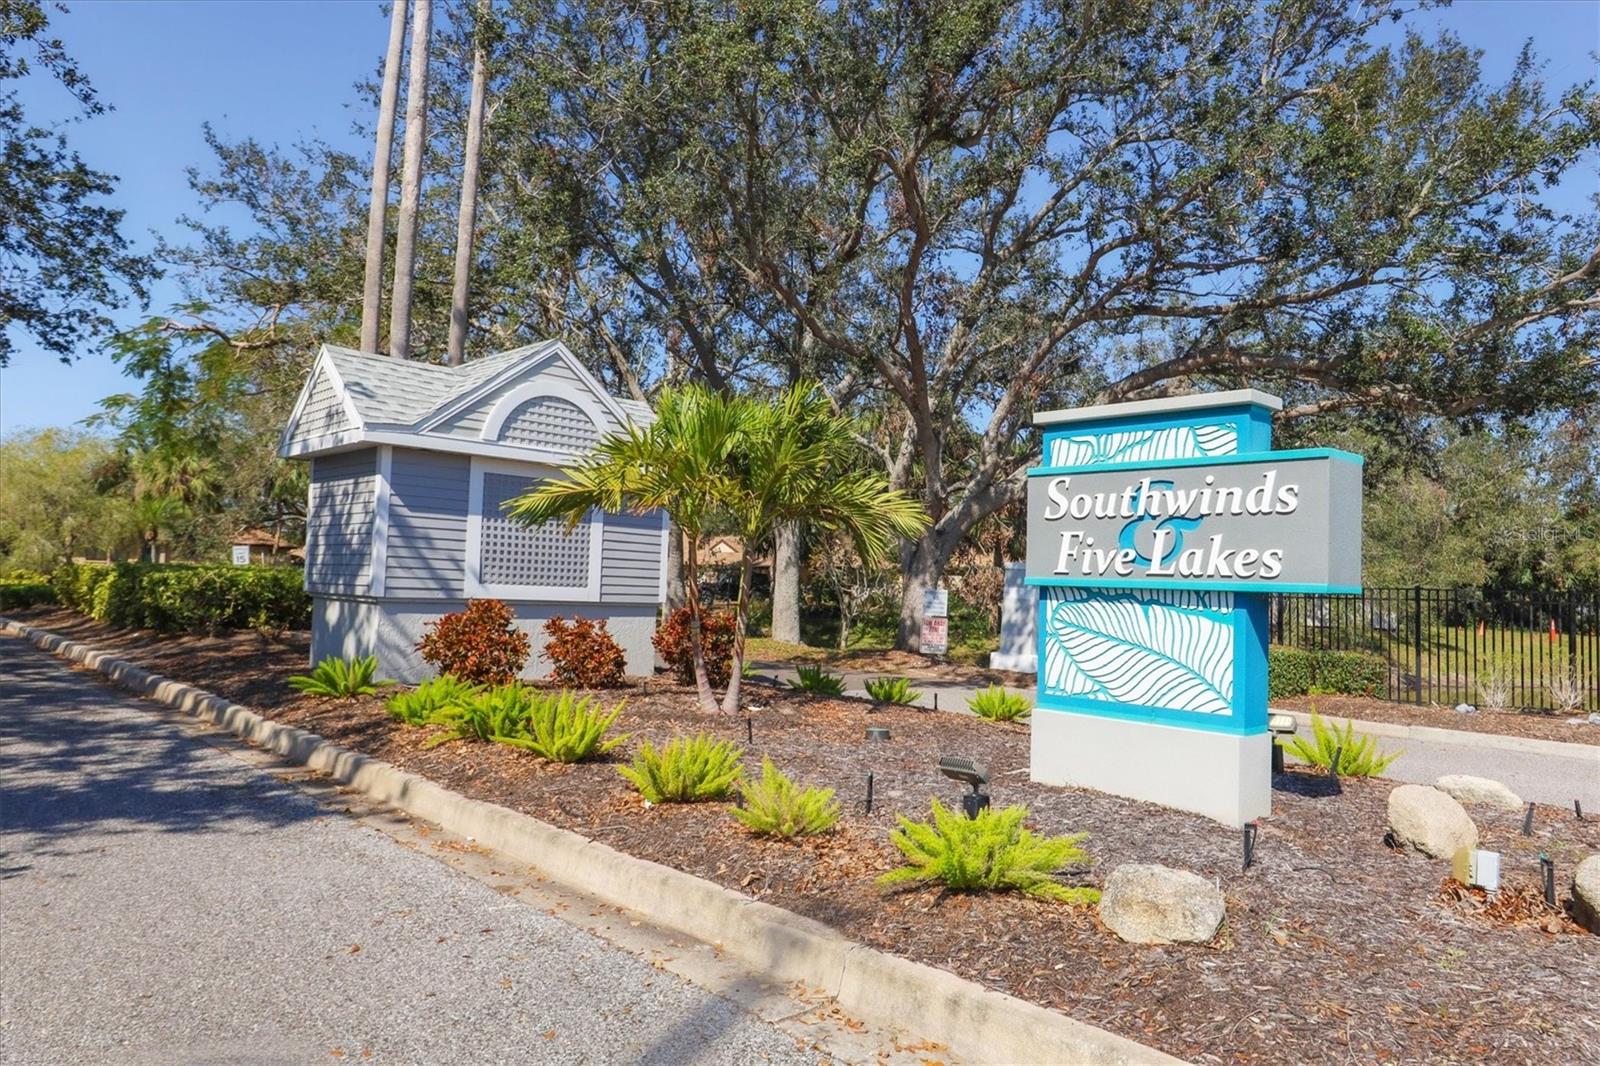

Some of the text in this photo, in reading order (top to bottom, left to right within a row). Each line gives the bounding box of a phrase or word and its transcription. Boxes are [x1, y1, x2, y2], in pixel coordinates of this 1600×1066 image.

[1044, 470, 1299, 520] Southwinds
[236, 555, 246, 563] 15
[1054, 529, 1284, 578] Five Lakes
